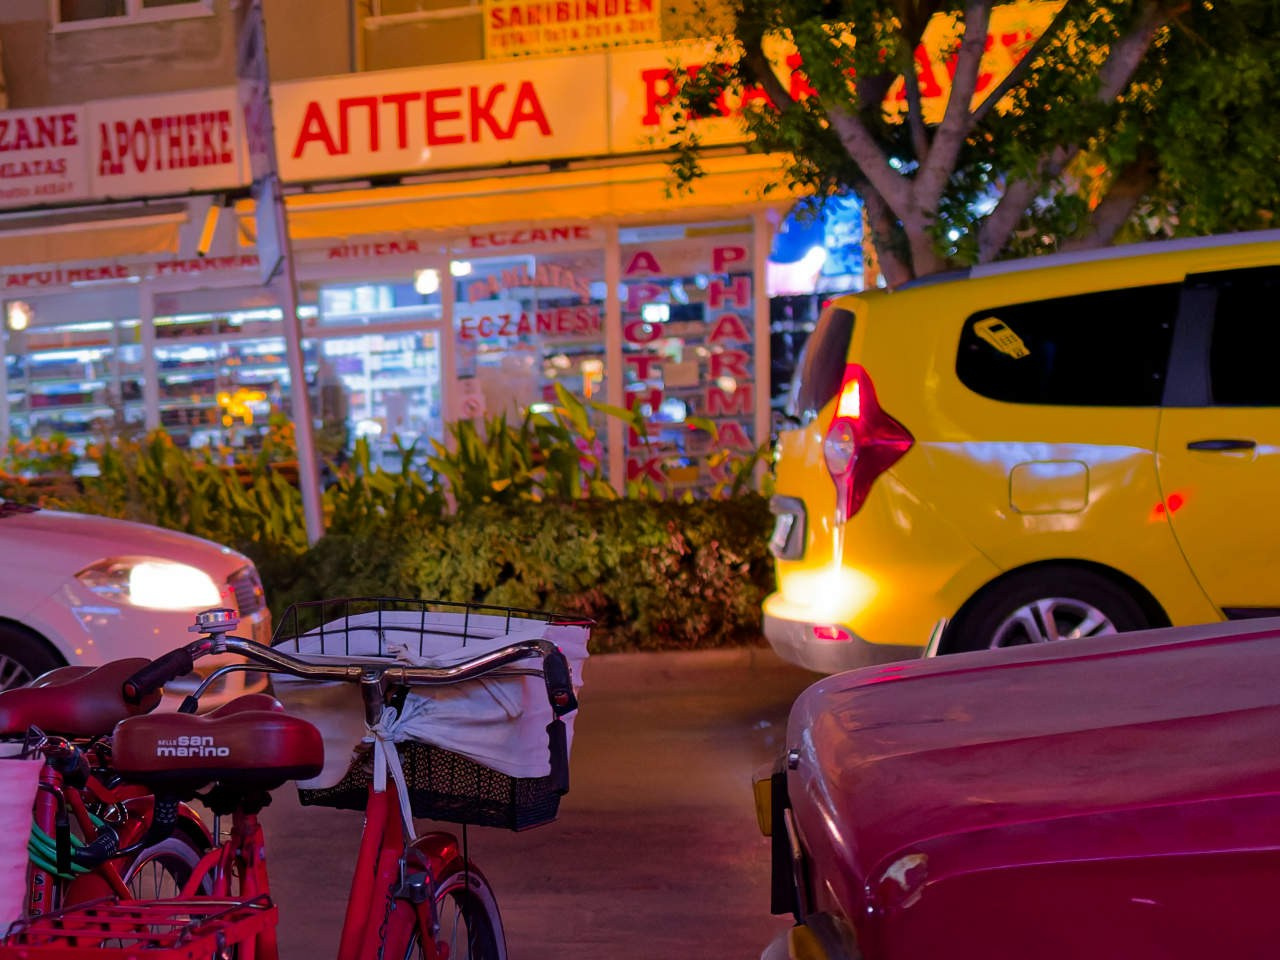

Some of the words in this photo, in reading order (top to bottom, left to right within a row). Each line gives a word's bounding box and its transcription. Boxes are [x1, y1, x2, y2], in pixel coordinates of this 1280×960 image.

[292, 80, 553, 159] АПТЕКА
[99, 109, 233, 177] APOTHEKE
[471, 226, 591, 248] ECZANE
[157, 746, 230, 757] marino
[178, 736, 214, 746] san
